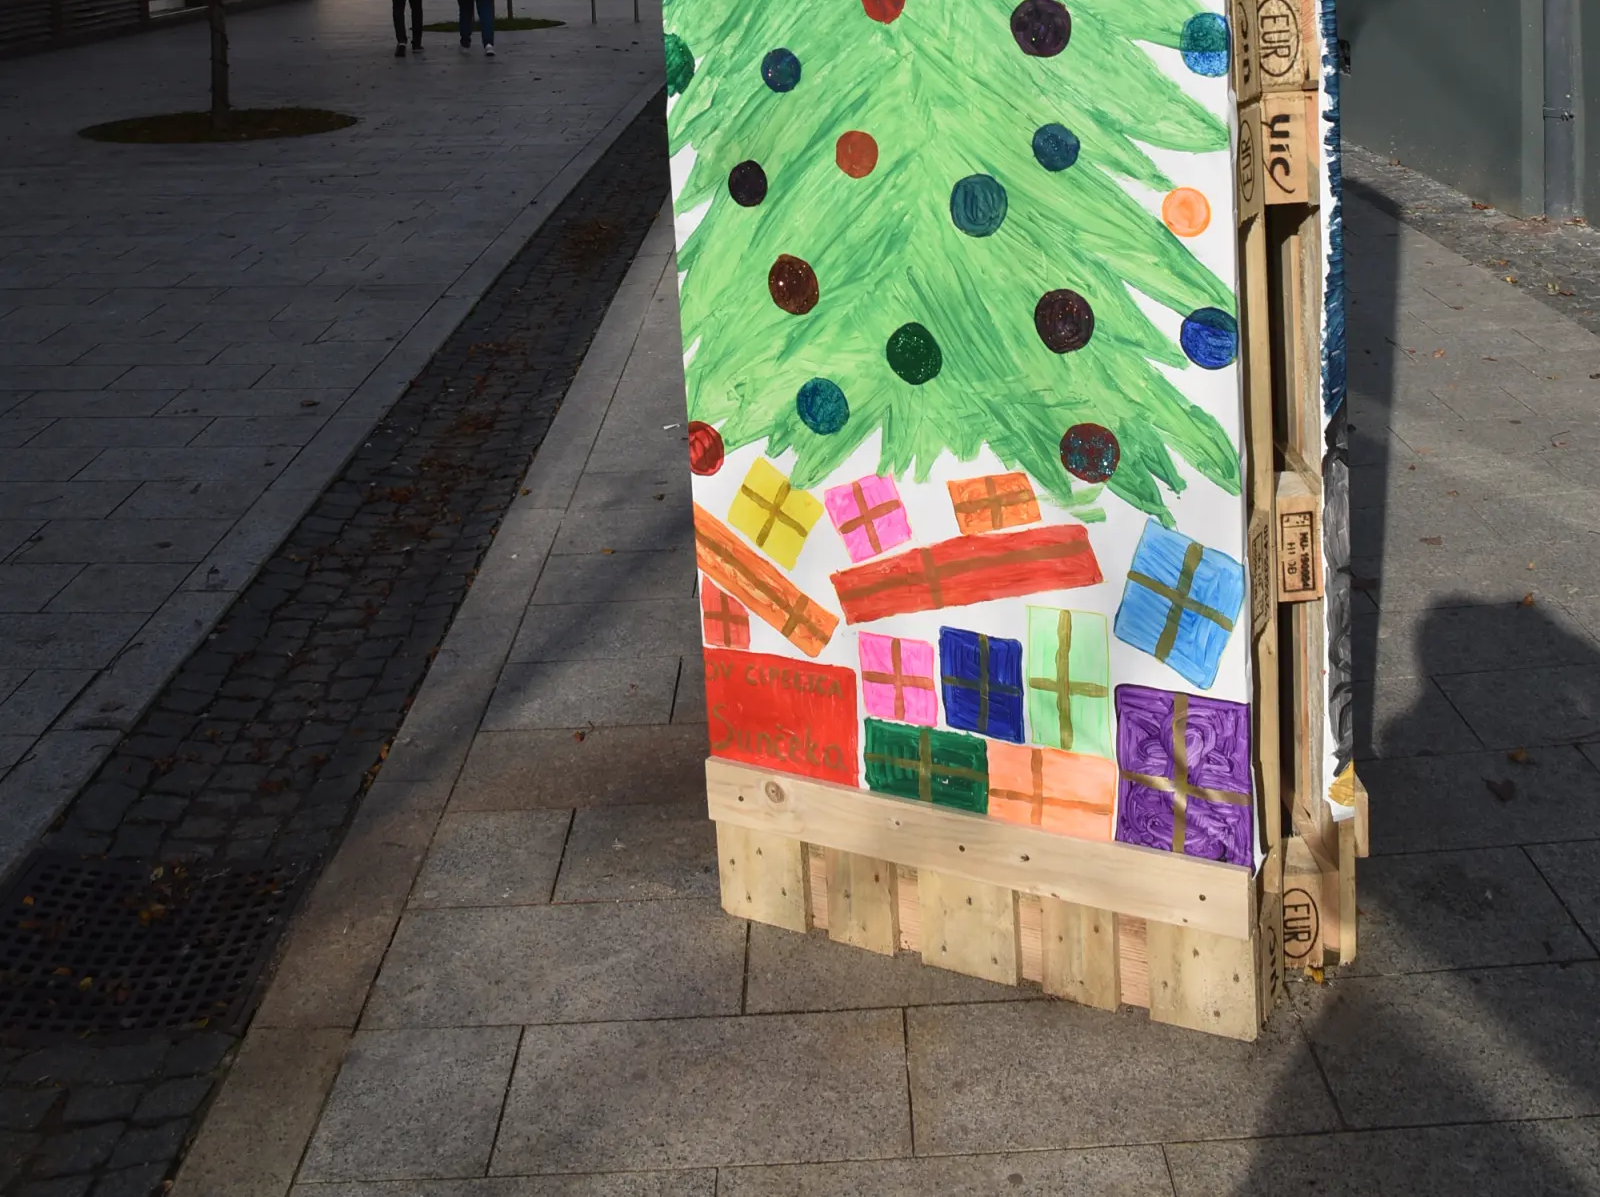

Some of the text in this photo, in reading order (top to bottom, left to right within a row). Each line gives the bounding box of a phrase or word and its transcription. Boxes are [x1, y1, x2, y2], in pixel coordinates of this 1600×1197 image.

[1259, 14, 1291, 59] EUR
[1241, 137, 1253, 187] EUR
[1283, 903, 1311, 943] EUR
